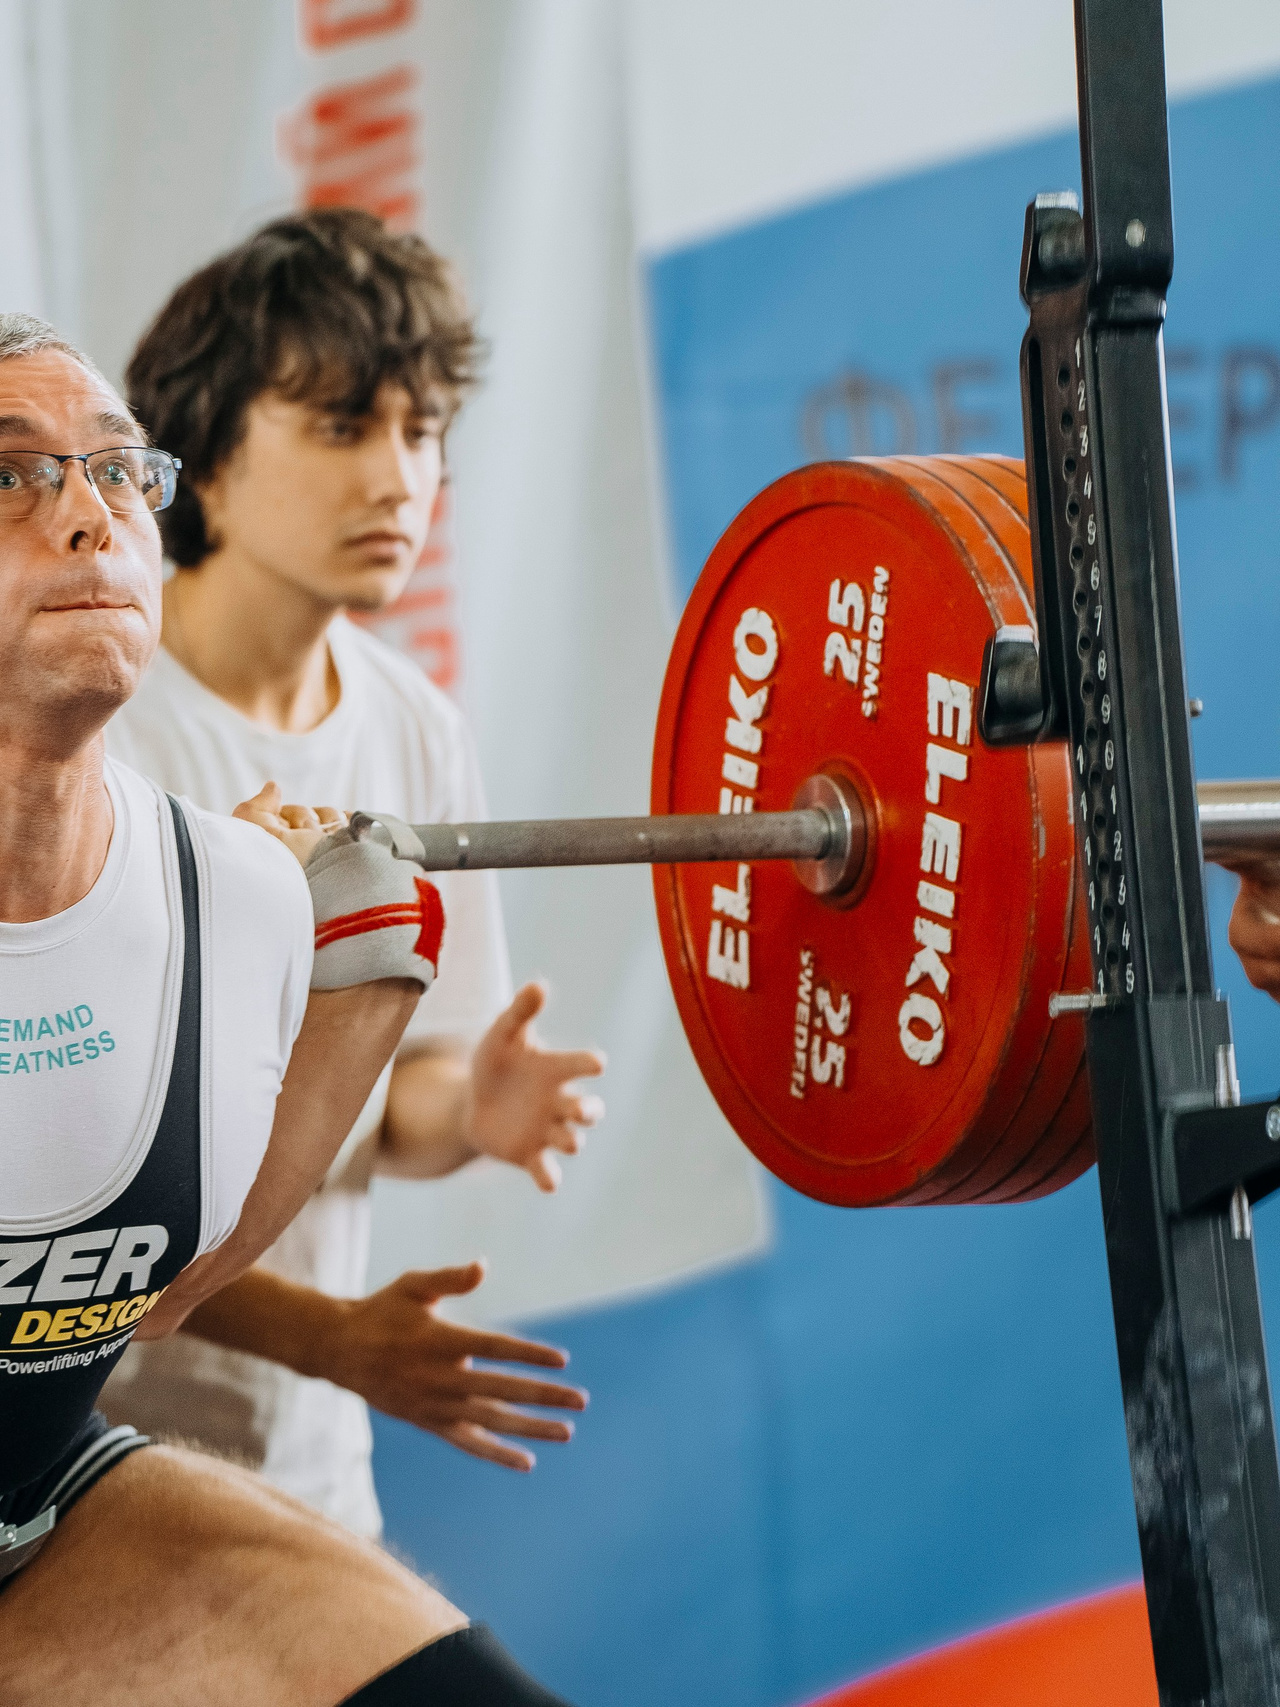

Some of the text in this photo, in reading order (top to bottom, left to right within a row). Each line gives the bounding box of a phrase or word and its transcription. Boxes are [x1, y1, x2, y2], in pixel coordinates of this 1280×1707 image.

[823, 578, 866, 685] 25
[861, 565, 890, 718] SWEDEN
[898, 671, 973, 1066] ELEIKO
[790, 948, 814, 1099] SWEDEN
[811, 986, 852, 1089] 25
